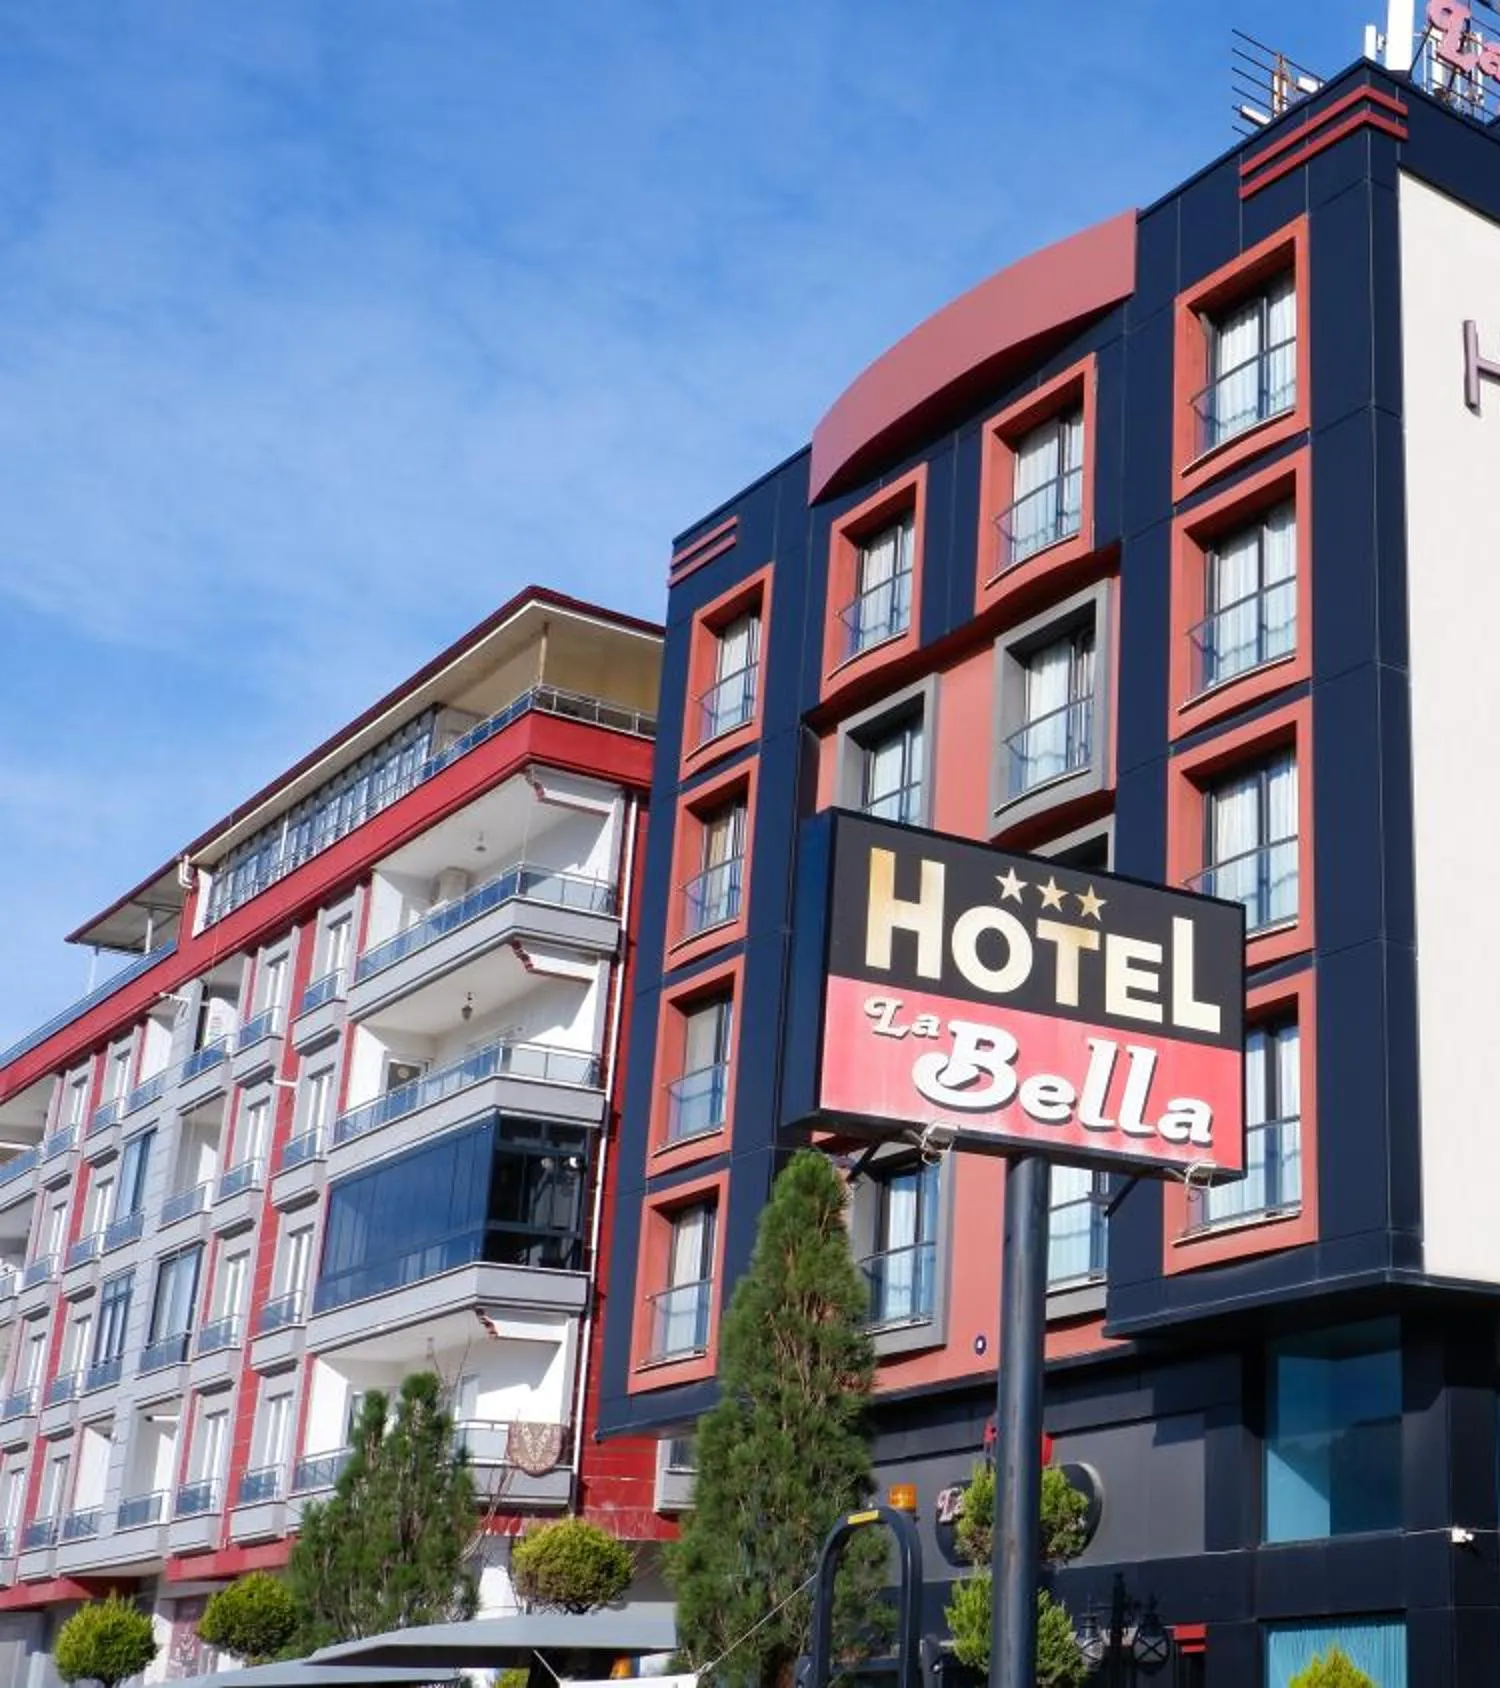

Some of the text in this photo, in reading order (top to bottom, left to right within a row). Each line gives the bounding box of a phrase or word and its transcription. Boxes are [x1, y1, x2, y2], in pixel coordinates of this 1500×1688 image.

[866, 847, 1221, 1033] HOTEL
[864, 996, 1213, 1146] La Bella
